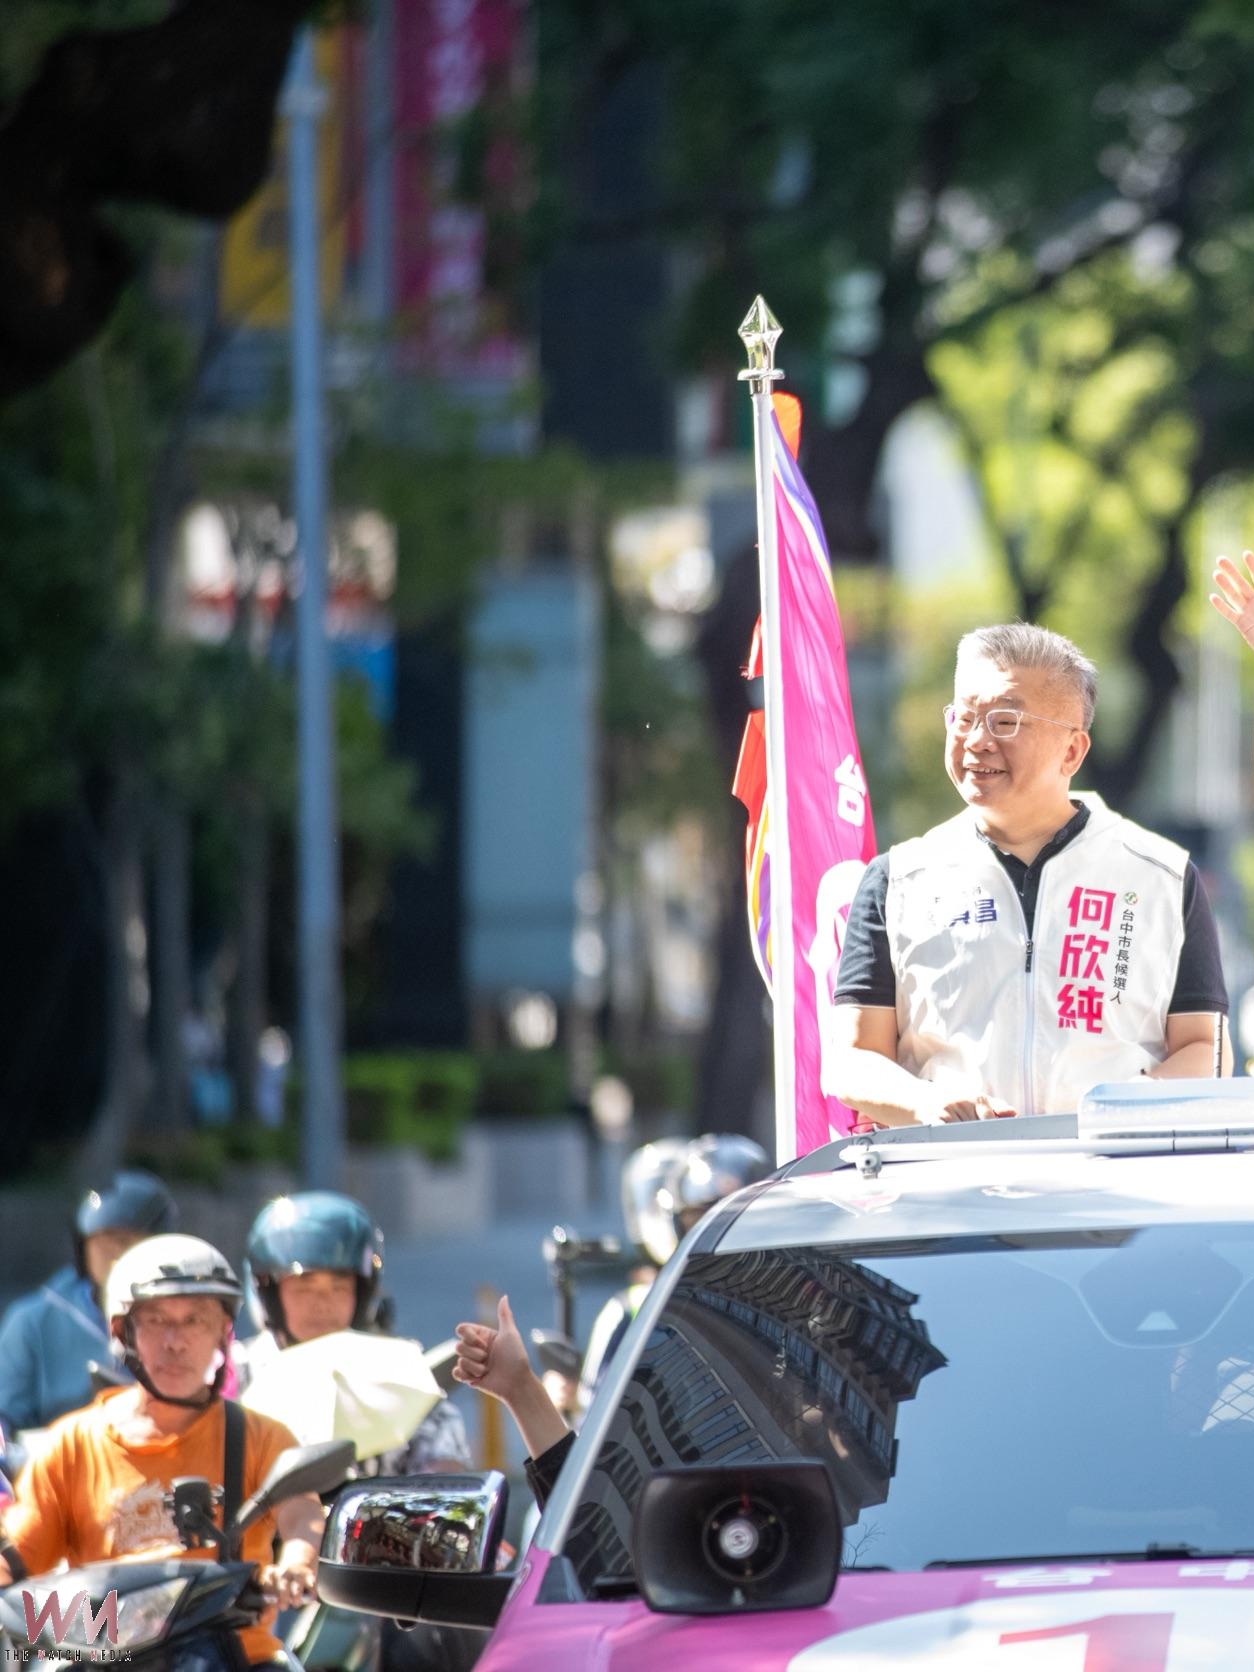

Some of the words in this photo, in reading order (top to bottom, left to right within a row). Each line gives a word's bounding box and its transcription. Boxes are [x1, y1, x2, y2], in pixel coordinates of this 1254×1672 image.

[1057, 886, 1116, 1034] 何欣純
[1109, 908, 1135, 1005] 台中市長候選人
